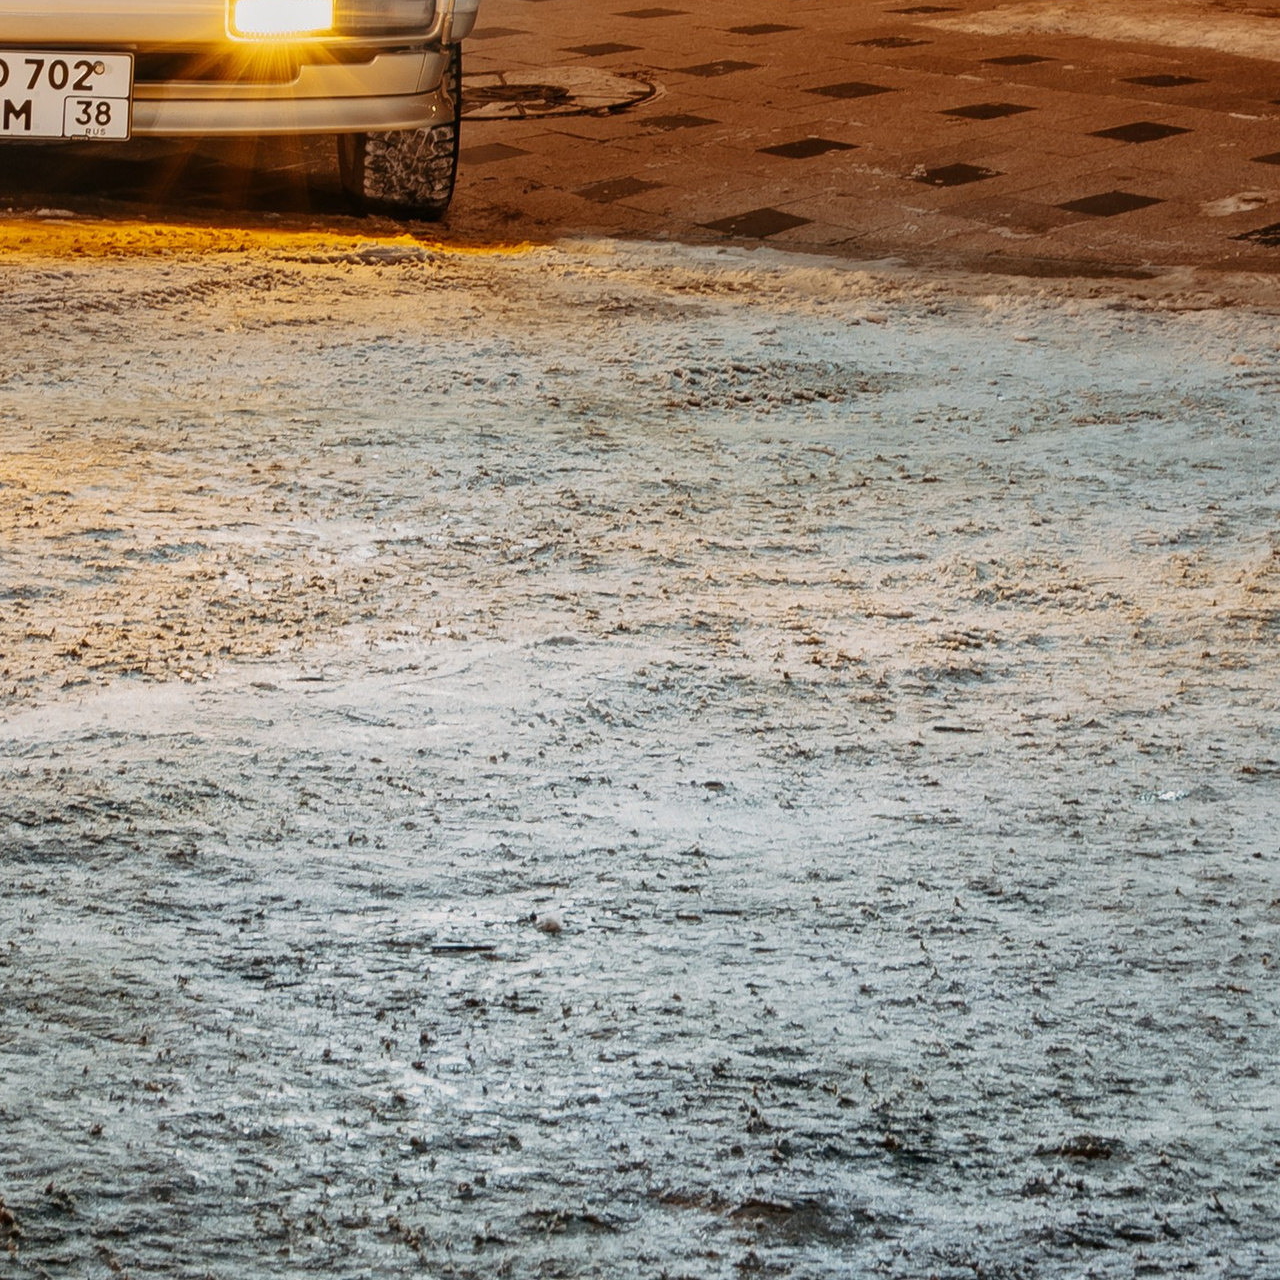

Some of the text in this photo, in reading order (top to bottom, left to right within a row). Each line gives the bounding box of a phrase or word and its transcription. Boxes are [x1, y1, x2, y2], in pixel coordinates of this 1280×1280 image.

[24, 58, 95, 91] 702
[75, 100, 112, 126] 38
[85, 127, 106, 136] RUS
